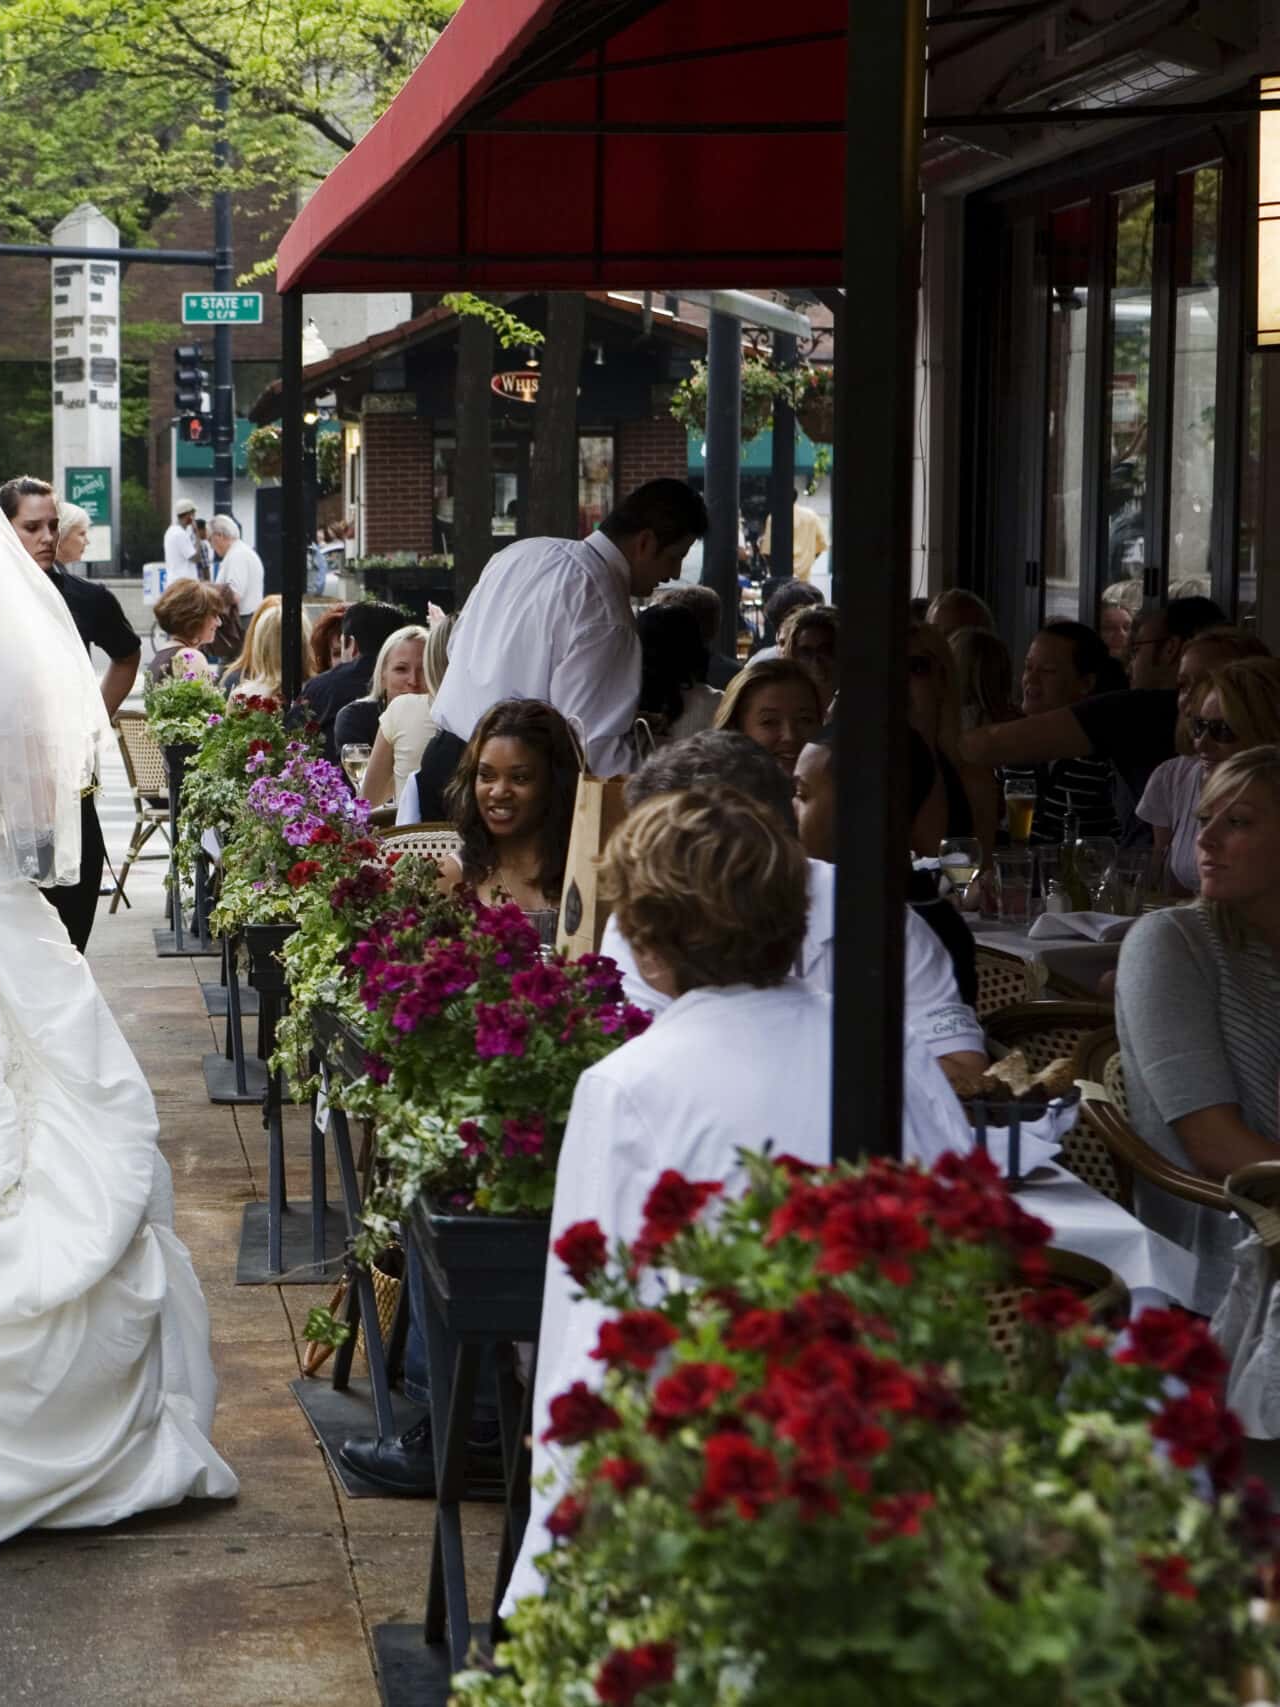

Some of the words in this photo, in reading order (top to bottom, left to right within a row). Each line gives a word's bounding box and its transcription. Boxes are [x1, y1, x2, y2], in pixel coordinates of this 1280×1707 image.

[201, 297, 239, 309] STATE
[243, 298, 254, 308] ST
[216, 310, 237, 320] E/W
[501, 375, 538, 392] WHIS
